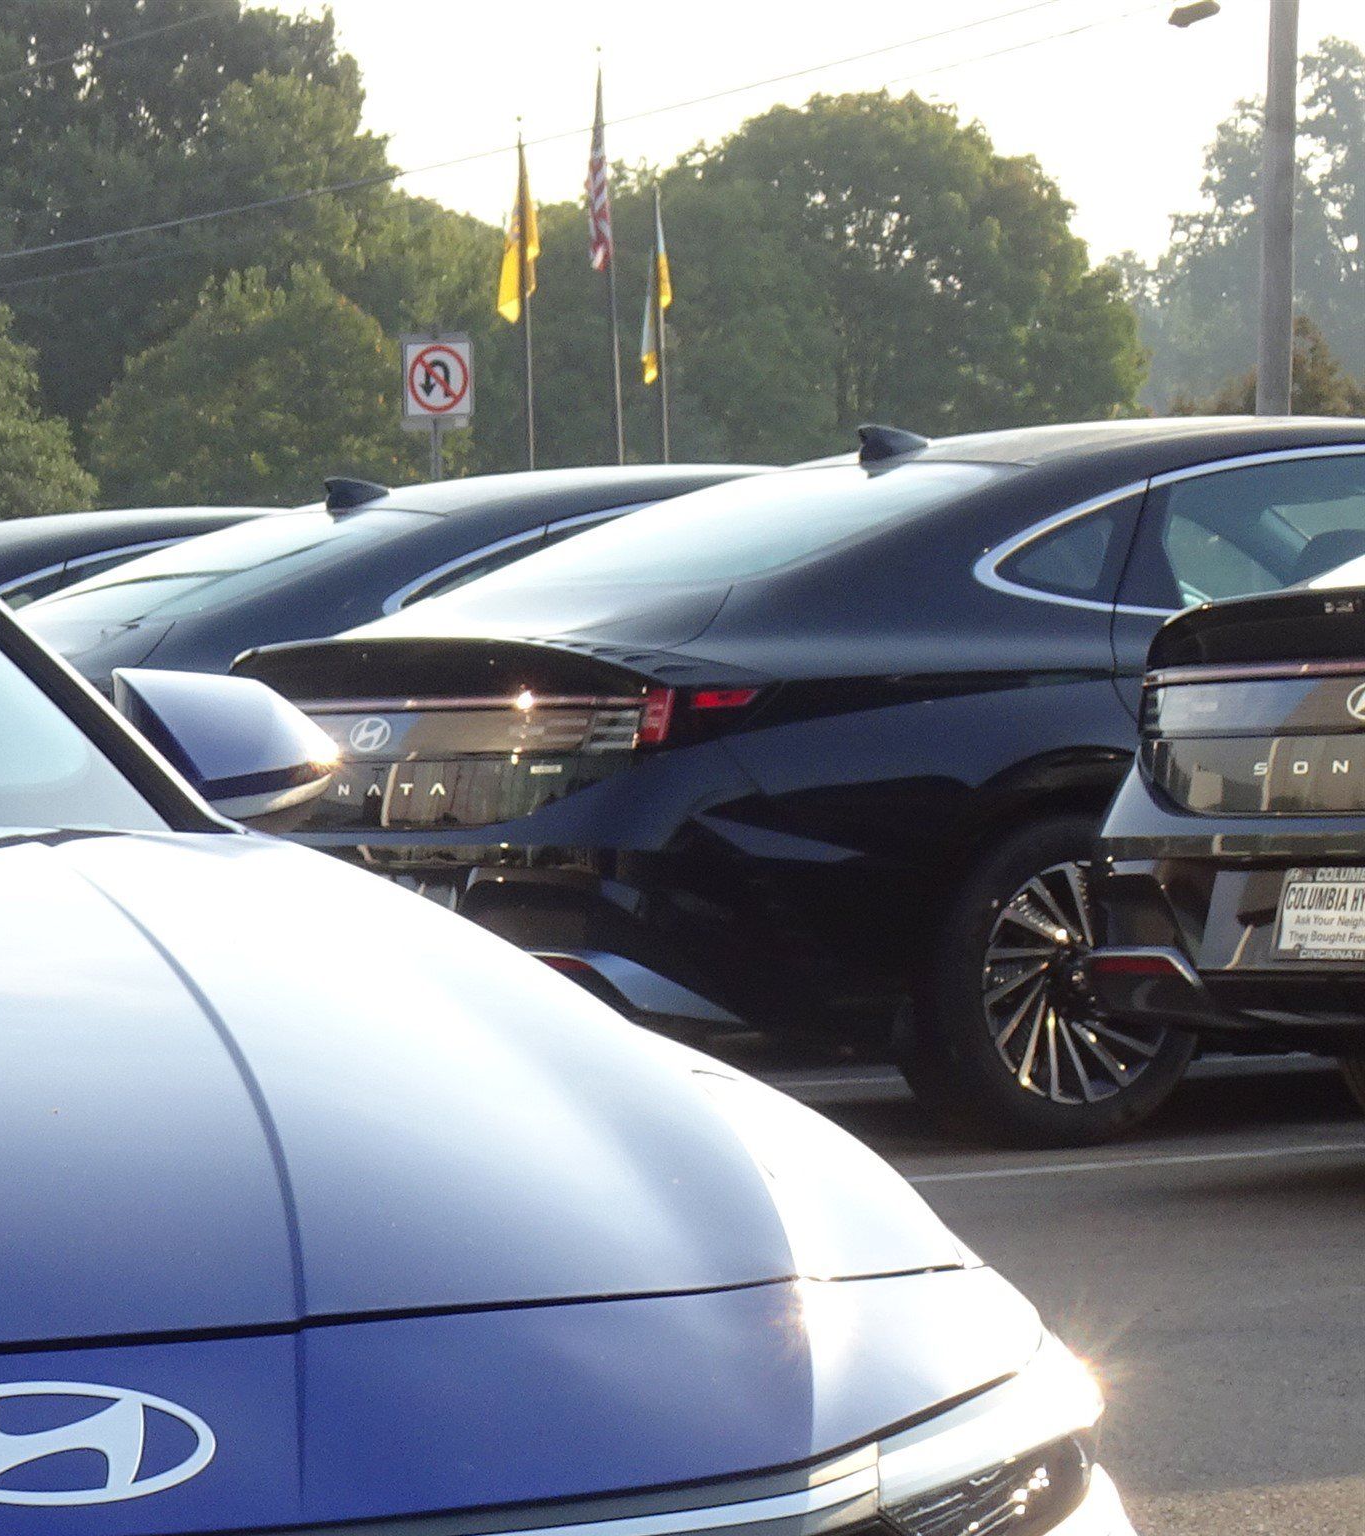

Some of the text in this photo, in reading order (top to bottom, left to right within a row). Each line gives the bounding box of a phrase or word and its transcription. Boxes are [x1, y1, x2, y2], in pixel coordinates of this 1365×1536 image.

[1253, 759, 1350, 775] SON
[337, 782, 446, 796] NATA
[1286, 886, 1365, 911] COLUMBIA HY
[1294, 913, 1365, 930] Ask Your Neigh
[1289, 930, 1309, 943] They
[1310, 930, 1346, 945] Bought
